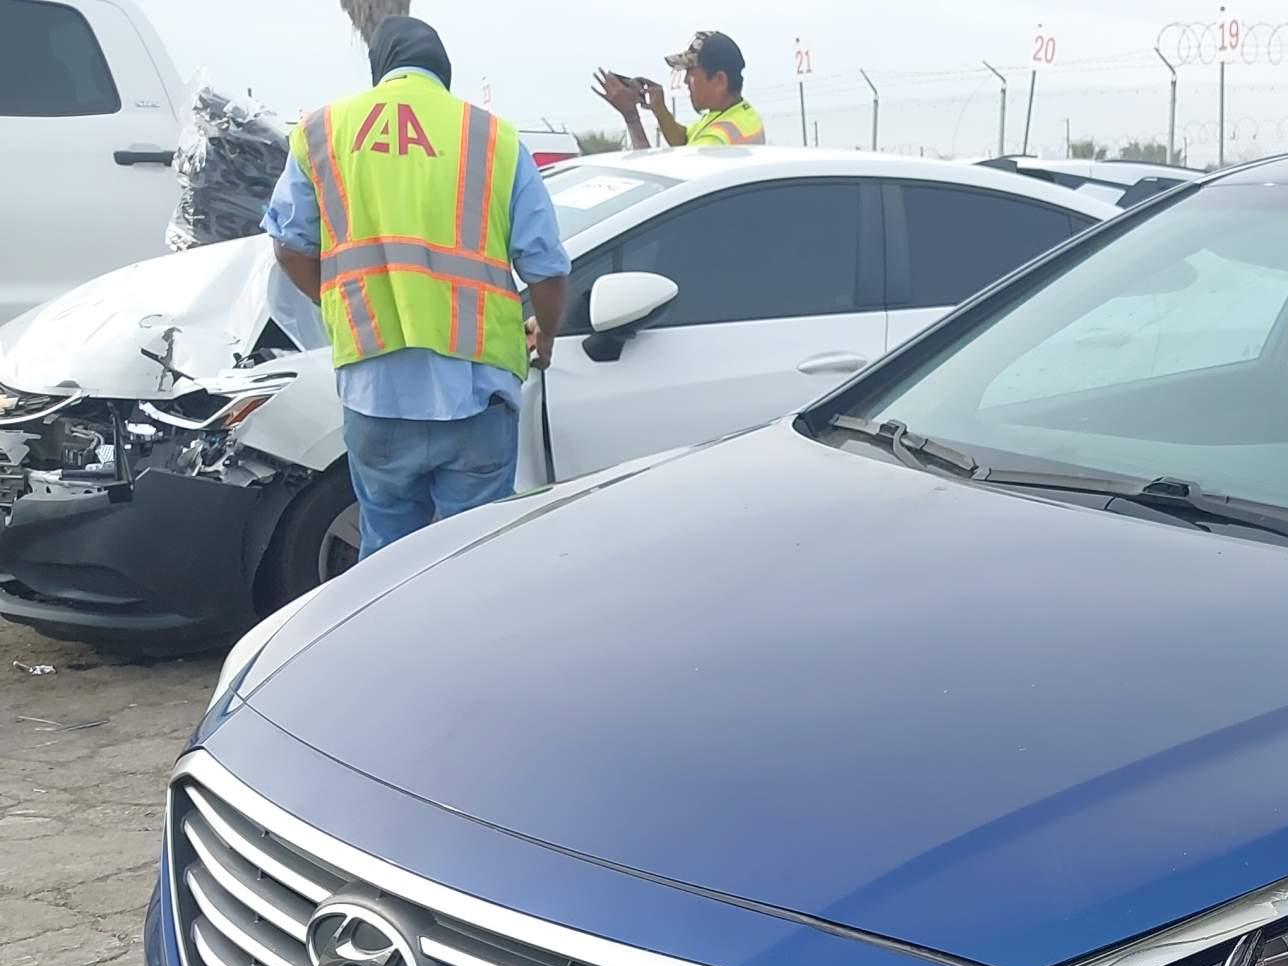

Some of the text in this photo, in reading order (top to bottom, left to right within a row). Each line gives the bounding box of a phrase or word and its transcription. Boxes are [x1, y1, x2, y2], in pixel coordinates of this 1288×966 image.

[1032, 35, 1056, 64] 20
[1218, 18, 1240, 52] 19
[795, 50, 812, 75] 21
